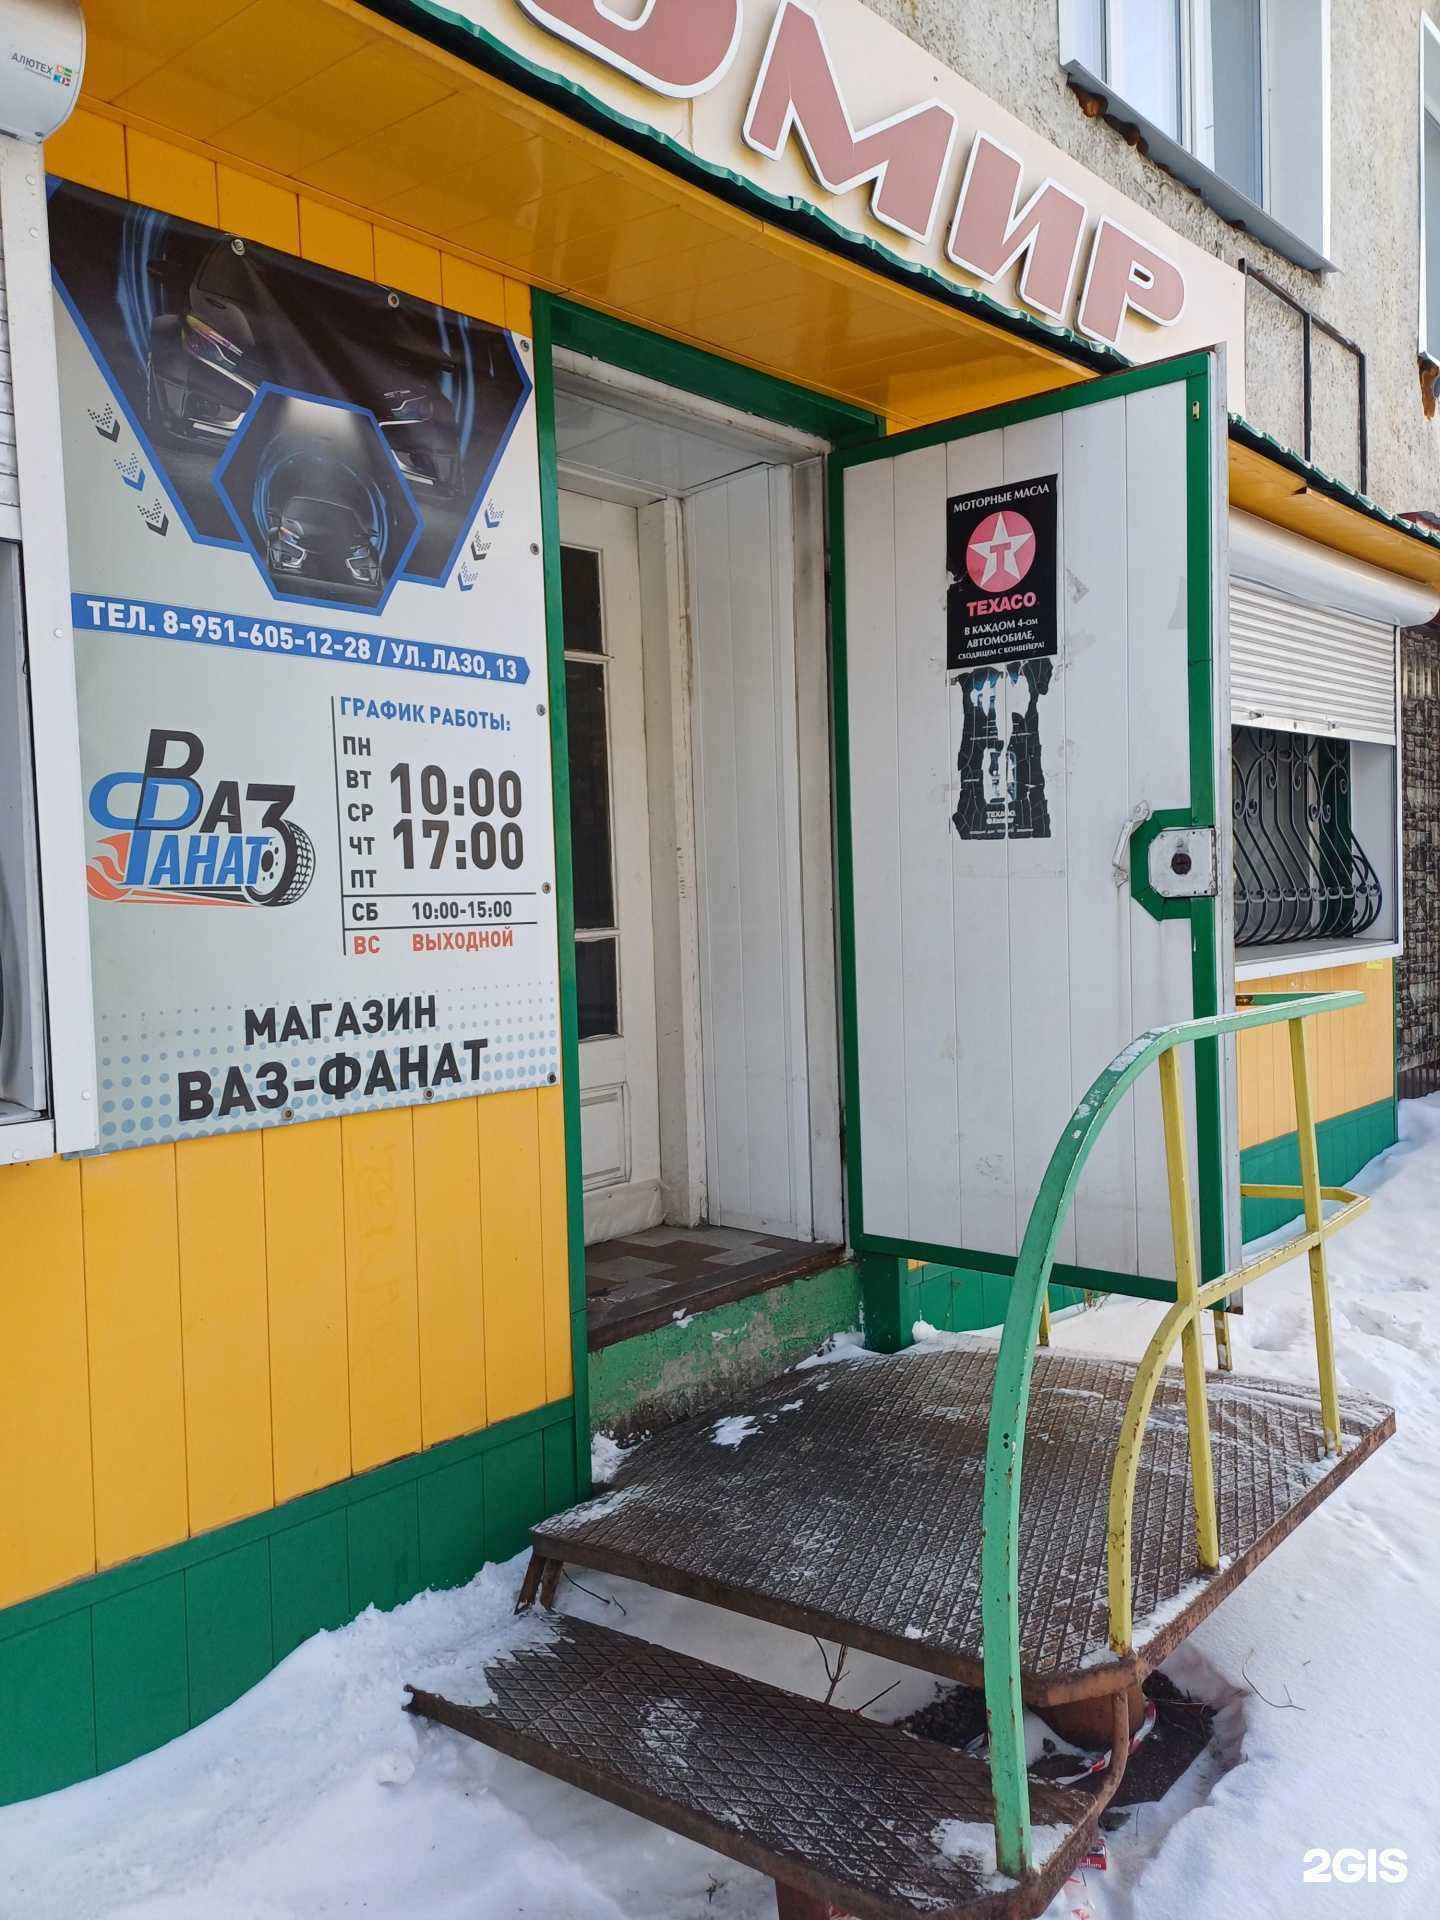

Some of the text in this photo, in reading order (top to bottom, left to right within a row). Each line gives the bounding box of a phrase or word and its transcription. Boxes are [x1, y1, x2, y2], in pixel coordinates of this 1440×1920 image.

[11, 52, 53, 75] АЛЮТЕХ
[953, 483, 1050, 513] МОТОРНЫЕ МАСЛА
[966, 592, 1038, 617] TEXACO
[964, 626, 970, 636] В
[972, 620, 1016, 635] КАЖДОМ
[966, 630, 1035, 648] АВТОМОБИЛЕ,
[86, 600, 155, 632] ТЕЛ.
[163, 610, 371, 660] 8-951-605-12-28
[391, 642, 426, 668] УЛ.
[431, 647, 491, 679] ЛАЗО,
[496, 658, 518, 680] 13
[958, 649, 997, 660] СХОДЯЩЕМ
[340, 696, 511, 731] ГРАФИК РАБОТЫ:
[343, 735, 371, 756] ПН
[346, 770, 372, 789] ВТ
[390, 762, 522, 818] 10:00
[347, 803, 374, 822] СР
[349, 836, 375, 855] ЧТ
[393, 819, 524, 870] 17:00
[350, 869, 377, 888] ПТ
[352, 900, 513, 921] СБ 10:00-15:00
[354, 926, 513, 955] ВС ВЫХОДНОЙ
[244, 994, 437, 1046] МАГАЗИН
[177, 1038, 489, 1121] ВАЗ-ФАНАТ
